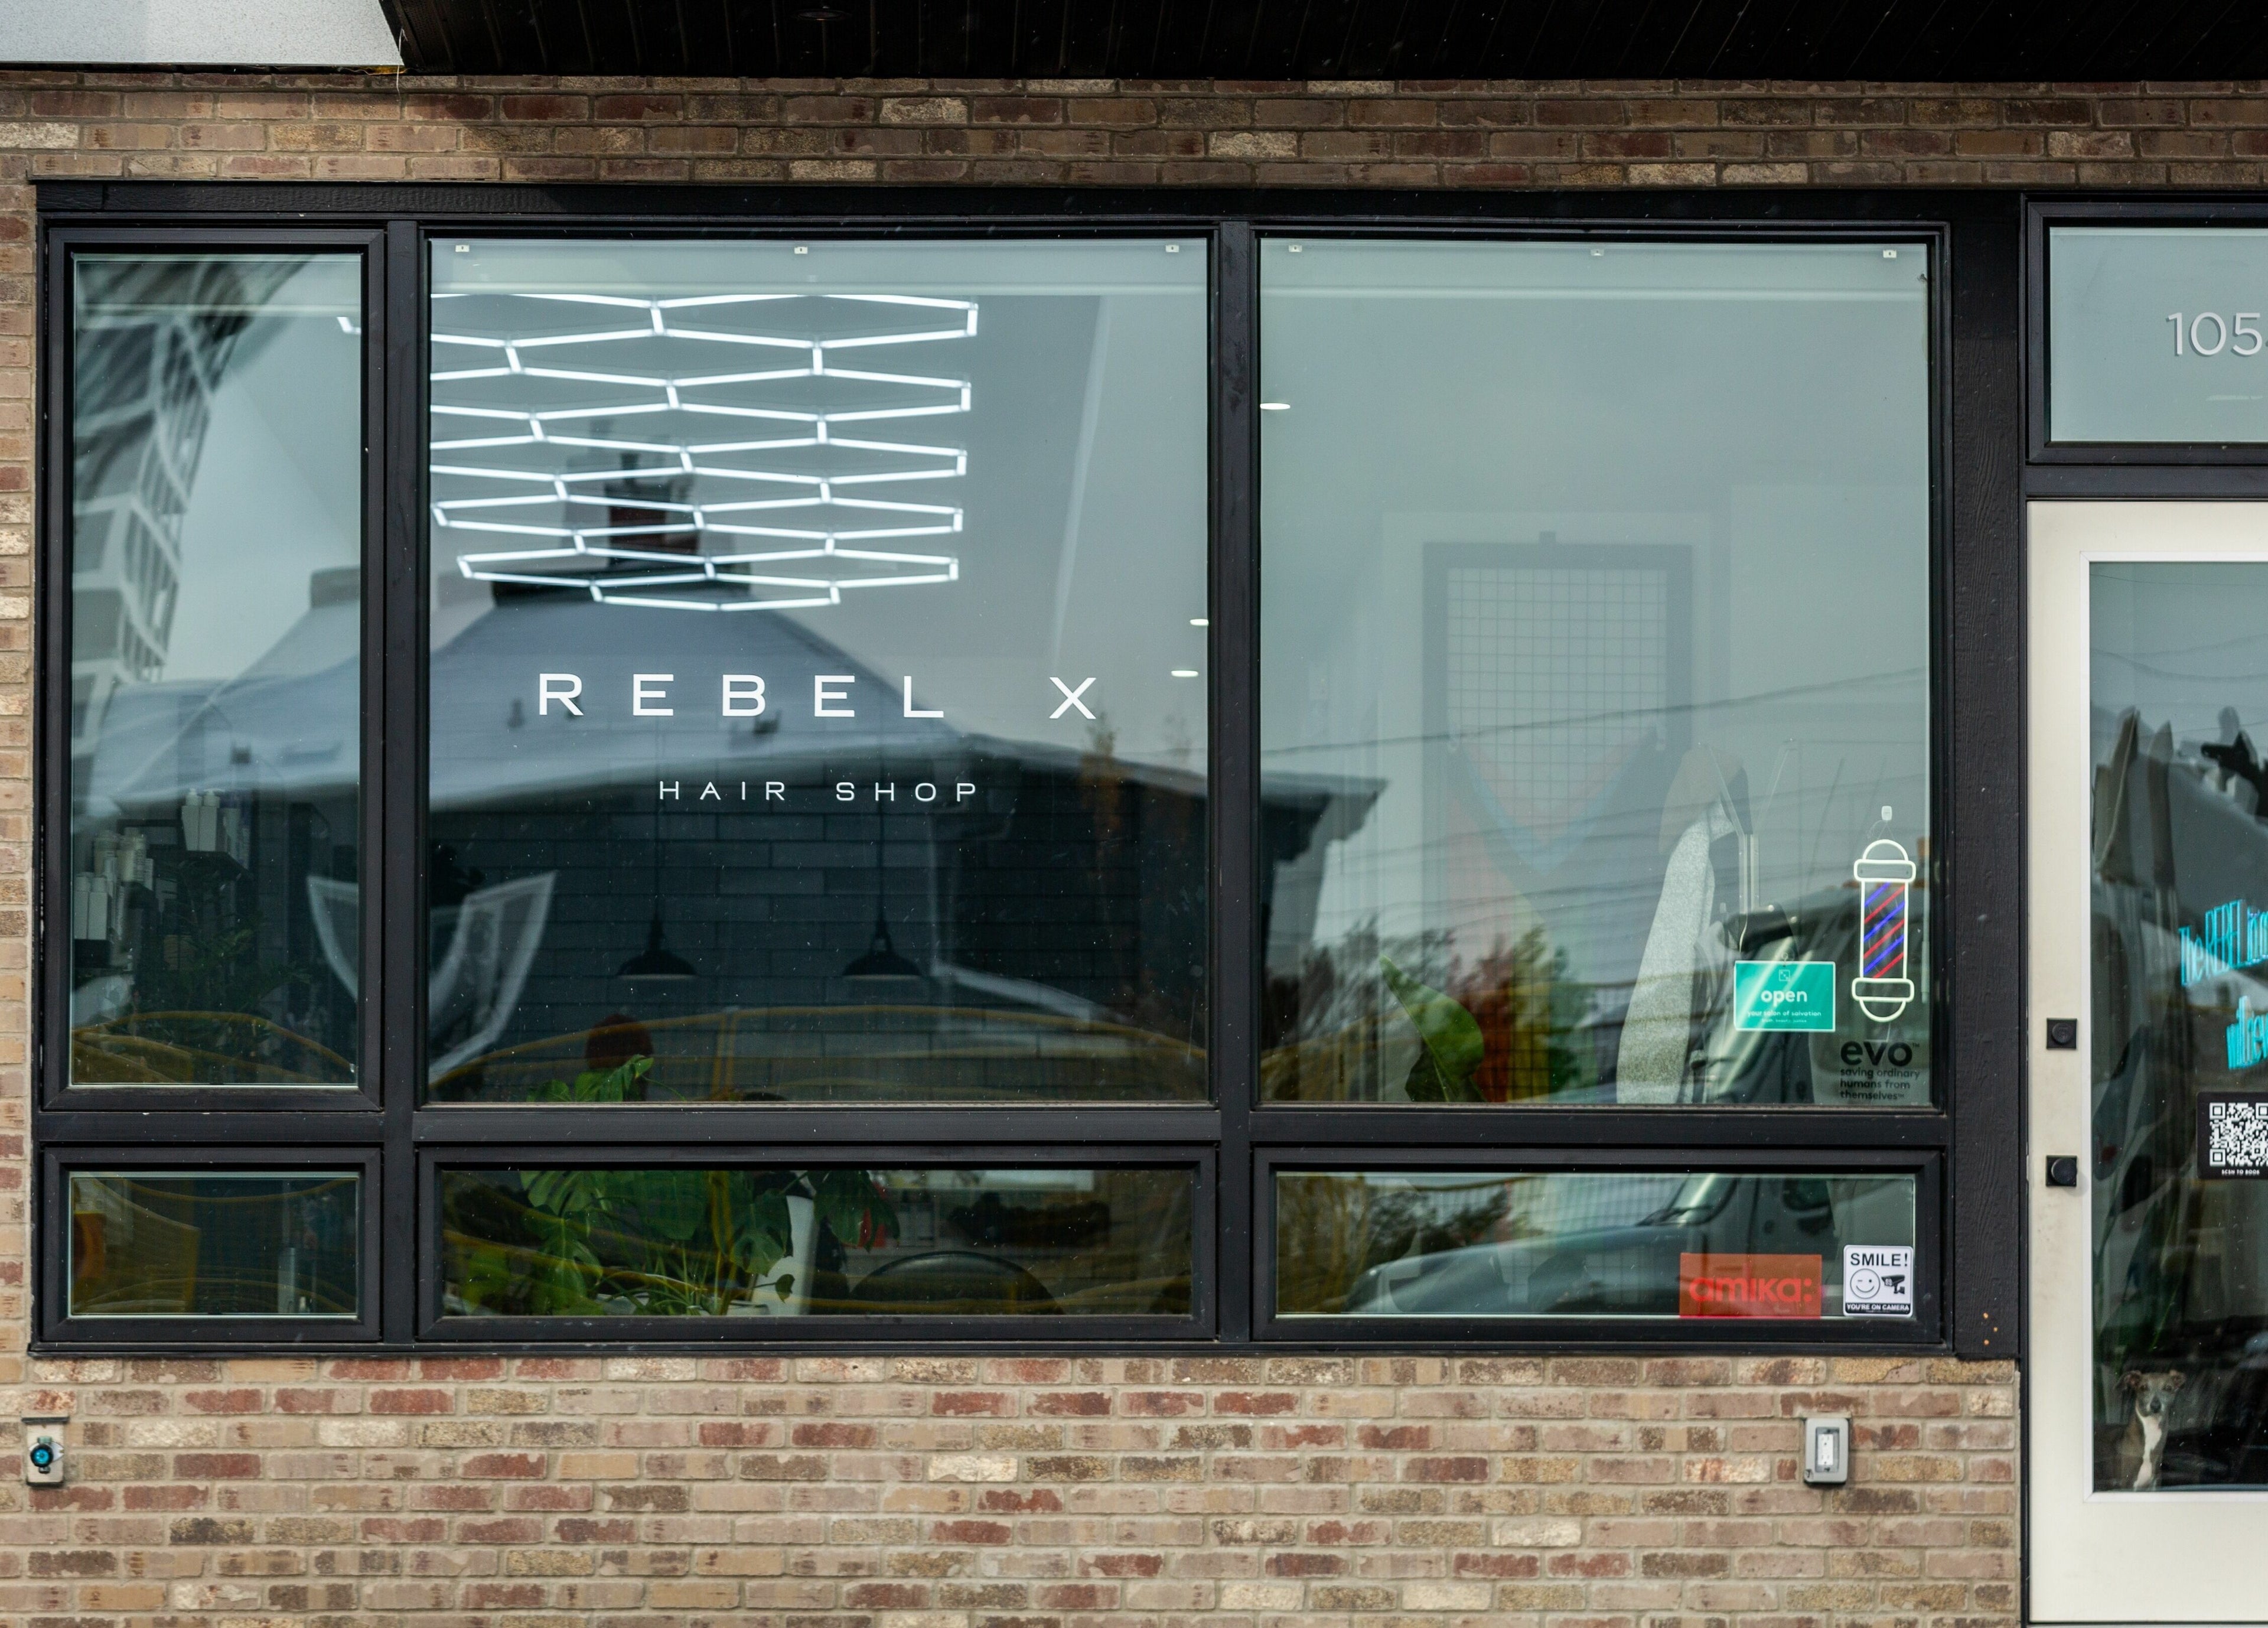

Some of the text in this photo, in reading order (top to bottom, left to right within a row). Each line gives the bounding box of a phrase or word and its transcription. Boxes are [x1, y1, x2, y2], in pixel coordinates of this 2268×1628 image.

[2167, 312, 2268, 356] 105
[539, 673, 1097, 719] REBEL X
[659, 781, 976, 802] HAIR SHOP
[1761, 990, 1807, 1007] open
[1840, 1067, 1920, 1080] saving ordinary
[1840, 1079, 1911, 1089] humans from
[1850, 1253, 1907, 1267] SMILE!
